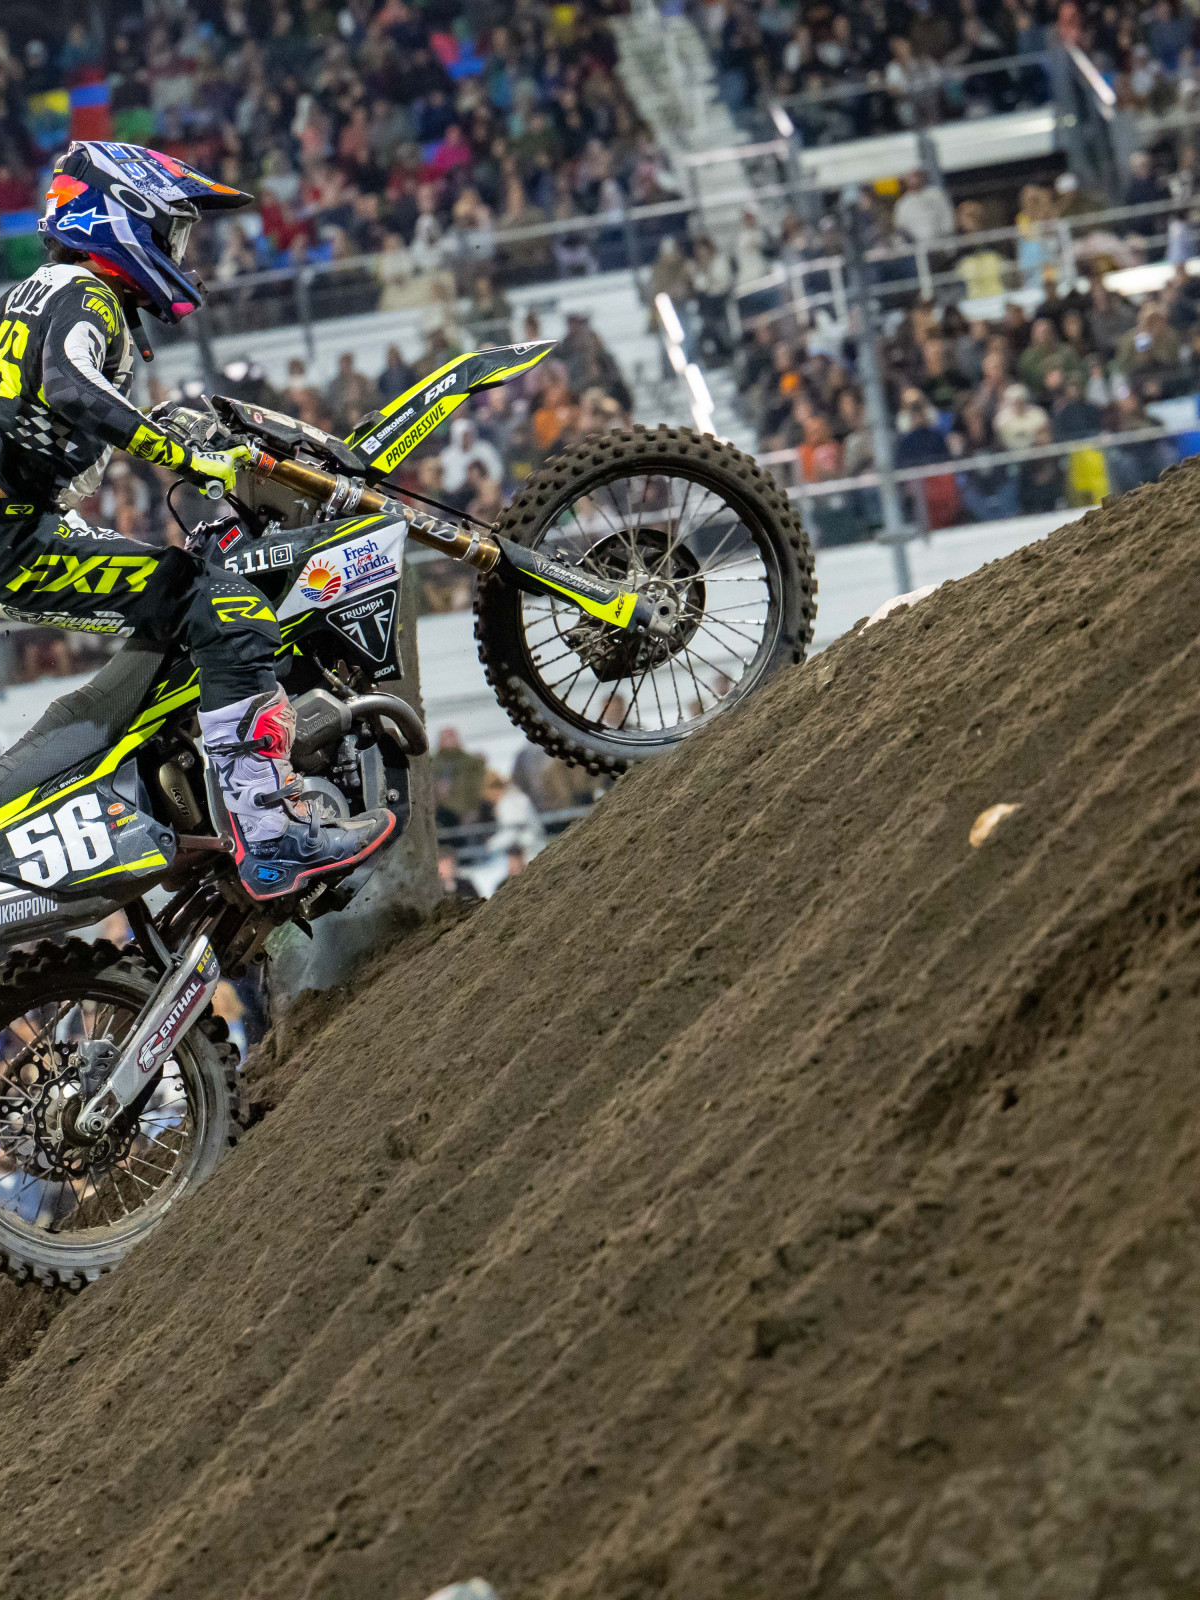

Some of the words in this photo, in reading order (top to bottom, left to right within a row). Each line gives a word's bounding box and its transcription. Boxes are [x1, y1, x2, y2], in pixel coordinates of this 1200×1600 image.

[424, 373, 458, 405] FXR
[377, 406, 415, 440] Silkolene
[385, 401, 446, 467] PROGRESSIVE
[224, 549, 269, 575] 5.11
[342, 539, 379, 562] Fresh
[5, 554, 160, 594] FXR
[342, 554, 390, 580] Florida
[548, 564, 611, 595] PERFORMANCE
[544, 569, 591, 592] LUBRICANTS
[43, 615, 126, 628] TRIUMPH
[339, 598, 384, 621] TRIUMPH
[373, 665, 396, 679] SKDA
[59, 774, 85, 789] SWOLL
[5, 793, 114, 888] 56
